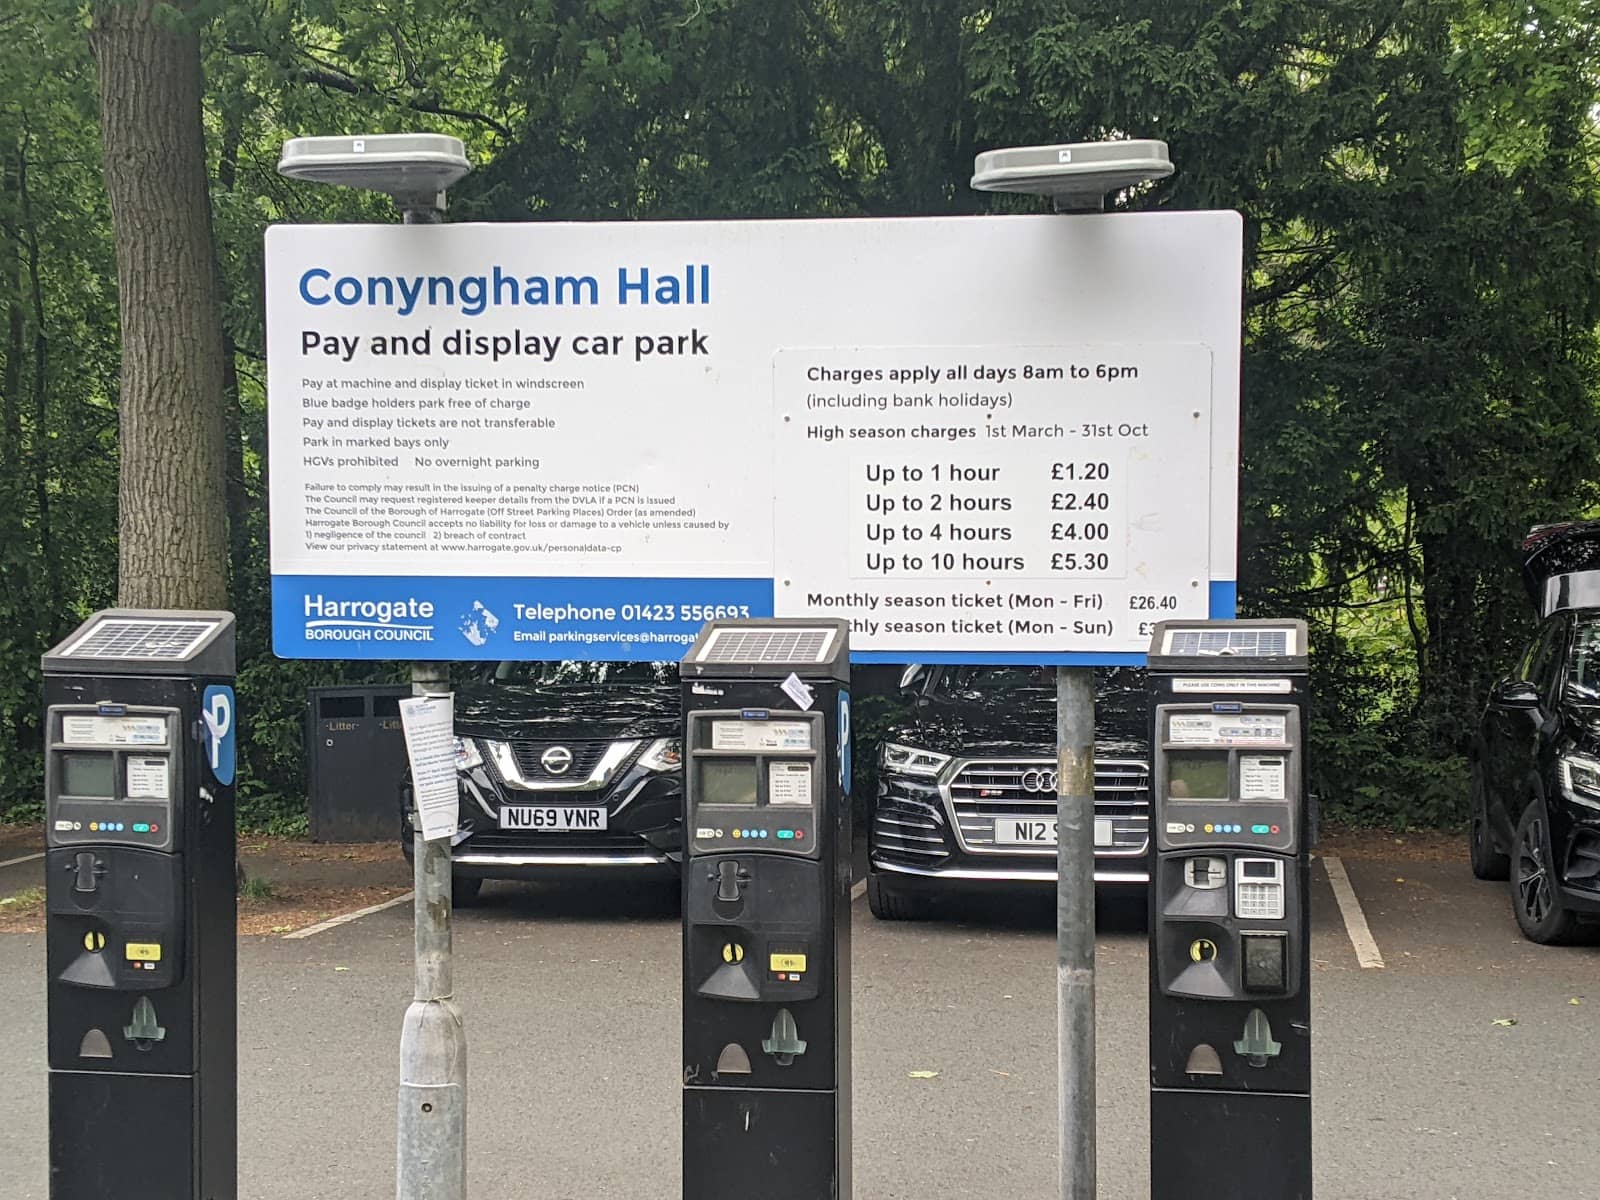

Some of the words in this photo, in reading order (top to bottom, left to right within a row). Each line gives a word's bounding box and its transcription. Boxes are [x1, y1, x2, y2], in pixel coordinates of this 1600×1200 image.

[299, 265, 598, 316] Conyngham
[618, 264, 709, 304] Hall
[302, 330, 360, 362] Pay
[370, 329, 430, 355] and
[442, 328, 561, 362] display
[572, 335, 623, 355] car
[635, 328, 708, 361] park
[807, 366, 883, 384] Charges
[889, 365, 940, 384] apply
[946, 364, 967, 380] all
[973, 364, 1016, 383] days
[1022, 364, 1063, 379] 8am
[1070, 364, 1089, 378] to
[1095, 364, 1138, 382] 6pm
[302, 378, 323, 390] Pay
[326, 378, 338, 388] at
[340, 377, 392, 388] machine
[394, 377, 417, 388] and
[420, 377, 462, 391] display
[464, 377, 498, 388] ticket
[501, 377, 512, 388] in
[515, 378, 584, 388] windscreen
[302, 397, 328, 408] Blue
[331, 397, 368, 410] badge
[371, 397, 415, 408] holders
[418, 397, 444, 410] park
[447, 397, 471, 408] free
[474, 397, 487, 408] of
[489, 397, 530, 410] charge
[806, 392, 887, 410] (including
[893, 393, 933, 407] bank
[938, 392, 1012, 410] holidays)
[302, 417, 324, 430] Pay
[326, 416, 349, 427] and
[351, 416, 393, 430] display
[396, 416, 436, 428] tickets
[439, 419, 458, 428] are
[461, 418, 481, 427] not
[484, 417, 555, 428] transferable
[807, 424, 844, 441] High
[849, 428, 905, 438] season
[910, 424, 976, 441] charges
[985, 424, 1006, 437] 1st
[1012, 423, 1063, 437] March
[1081, 423, 1113, 437] 31st
[1118, 423, 1148, 436] Oct
[302, 436, 328, 446] Park
[332, 436, 342, 447] in
[345, 436, 390, 447] marked
[393, 436, 421, 449] bays
[423, 436, 449, 450] only
[303, 455, 334, 466] HGVs
[337, 455, 398, 468] prohibited
[414, 456, 432, 466] No
[434, 456, 492, 469] overnight
[495, 456, 539, 469] parking
[866, 464, 895, 485] Up
[902, 465, 923, 481] to
[931, 463, 939, 481] 1
[950, 463, 1000, 481] hour
[1051, 462, 1109, 480] £1.20
[304, 482, 335, 491] Failure
[336, 483, 347, 491] to
[347, 483, 382, 493] comply
[383, 484, 403, 493] may
[404, 483, 430, 491] result
[432, 482, 441, 491] in
[443, 483, 458, 492] the
[460, 483, 492, 494] issuing
[493, 483, 504, 492] of
[513, 483, 547, 494] penalty
[548, 483, 580, 494] charge
[582, 483, 610, 492] notice
[612, 483, 639, 493] (PCN)
[866, 494, 895, 515] Up
[902, 495, 923, 511] to
[930, 494, 941, 511] 2
[950, 493, 1011, 511] hours
[1051, 492, 1108, 510] £2.40
[305, 518, 350, 528] Harrogate
[351, 518, 391, 529] Borough
[392, 518, 426, 527] Council
[428, 519, 463, 528] accepts
[479, 519, 512, 530] liability
[513, 519, 526, 528] for
[528, 519, 546, 528] loss
[559, 520, 597, 530] damage
[599, 520, 608, 528] to
[618, 519, 650, 528] vehicle
[652, 519, 681, 528] unless
[683, 519, 715, 528] caused
[718, 520, 730, 530] by
[305, 530, 312, 540] 1)
[313, 530, 363, 540] negligence
[364, 530, 375, 539] of
[376, 530, 392, 539] the
[393, 530, 426, 539] council
[432, 530, 441, 540] 2)
[443, 531, 474, 539] breach
[476, 531, 486, 539] of
[488, 531, 526, 540] contract
[866, 523, 895, 545] Up
[902, 524, 922, 540] to
[929, 523, 942, 540] 4
[950, 523, 1011, 540] hours
[1050, 522, 1108, 540] £4.00
[304, 542, 328, 550] View
[346, 542, 380, 552] privacy
[381, 543, 428, 551] statement
[429, 543, 439, 551] at
[440, 543, 622, 553] www.harrogate.gov.uk/personaldata-cp
[866, 553, 895, 574] Up
[902, 553, 922, 570] to
[931, 552, 954, 570] 10
[962, 552, 1024, 570] hours
[1050, 552, 1108, 570] £5.30
[303, 594, 434, 624] Harrogate
[807, 592, 879, 610] Monthly
[884, 596, 945, 607] season
[951, 593, 1003, 607] ticket
[1008, 593, 1053, 610] (Mon
[1074, 593, 1102, 610] Fri)
[1129, 595, 1176, 610] £26.40
[513, 603, 616, 623] Telephone
[621, 604, 675, 620] 01423
[680, 604, 750, 622] 556693
[305, 628, 371, 640] BOROUGH
[373, 627, 434, 640] COUNCIL
[513, 630, 546, 641] Email
[849, 618, 879, 636] thly
[884, 622, 945, 633] season
[951, 618, 1003, 633] ticket
[1008, 619, 1053, 636] (Mon
[1073, 620, 1112, 636] Sun)
[328, 721, 355, 731] Litter
[382, 720, 402, 729] Litt
[508, 808, 557, 826] NU69
[563, 809, 600, 827] VNR
